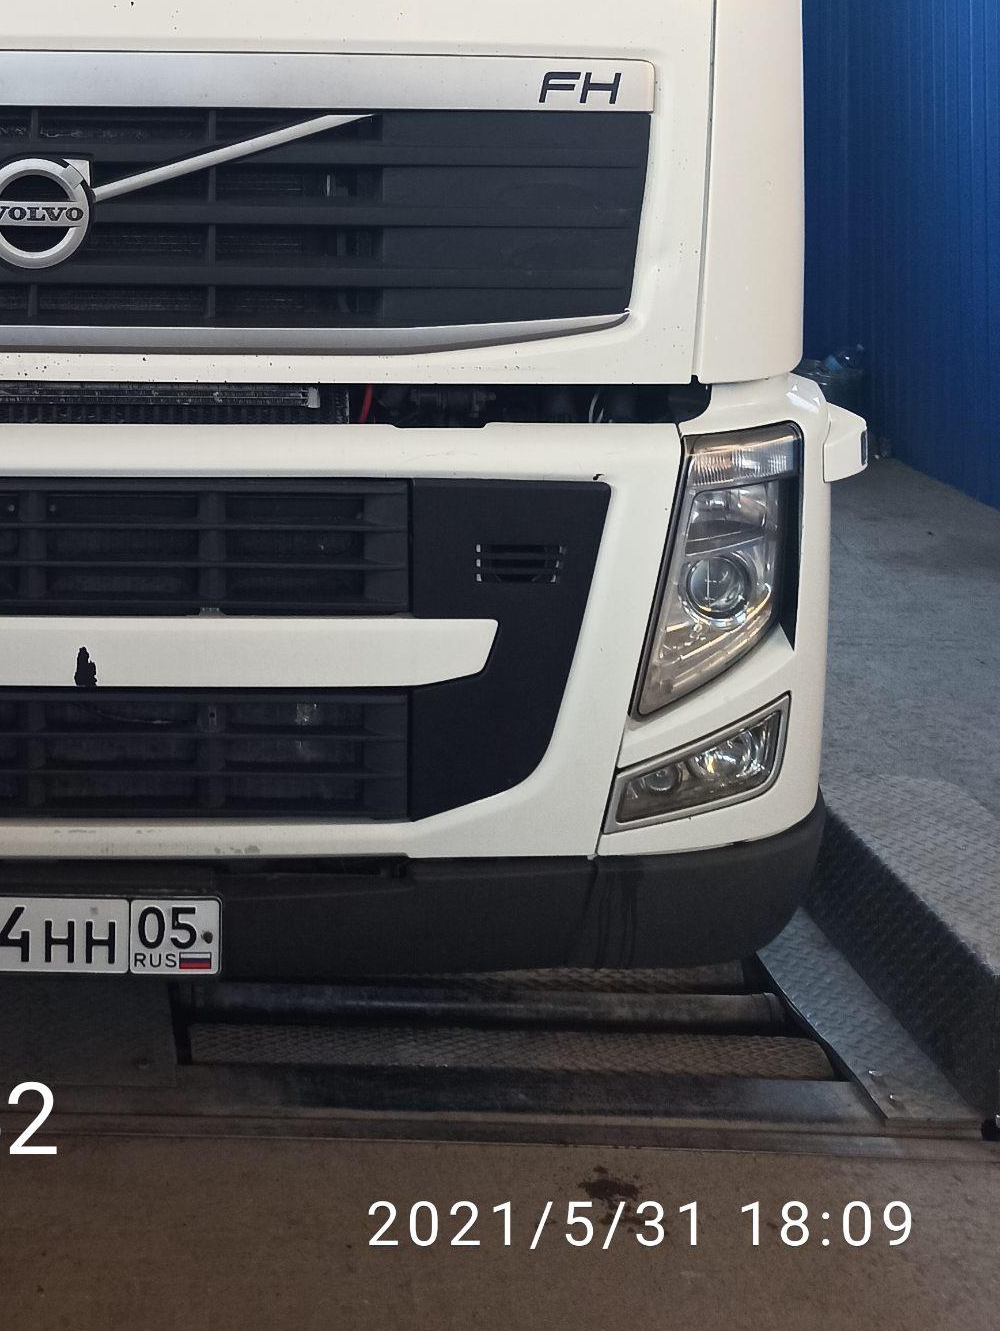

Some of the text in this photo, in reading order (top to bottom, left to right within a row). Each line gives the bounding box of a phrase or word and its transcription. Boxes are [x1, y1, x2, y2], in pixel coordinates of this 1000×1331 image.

[538, 71, 622, 105] FH
[137, 905, 198, 950] 05
[133, 953, 178, 969] RUS
